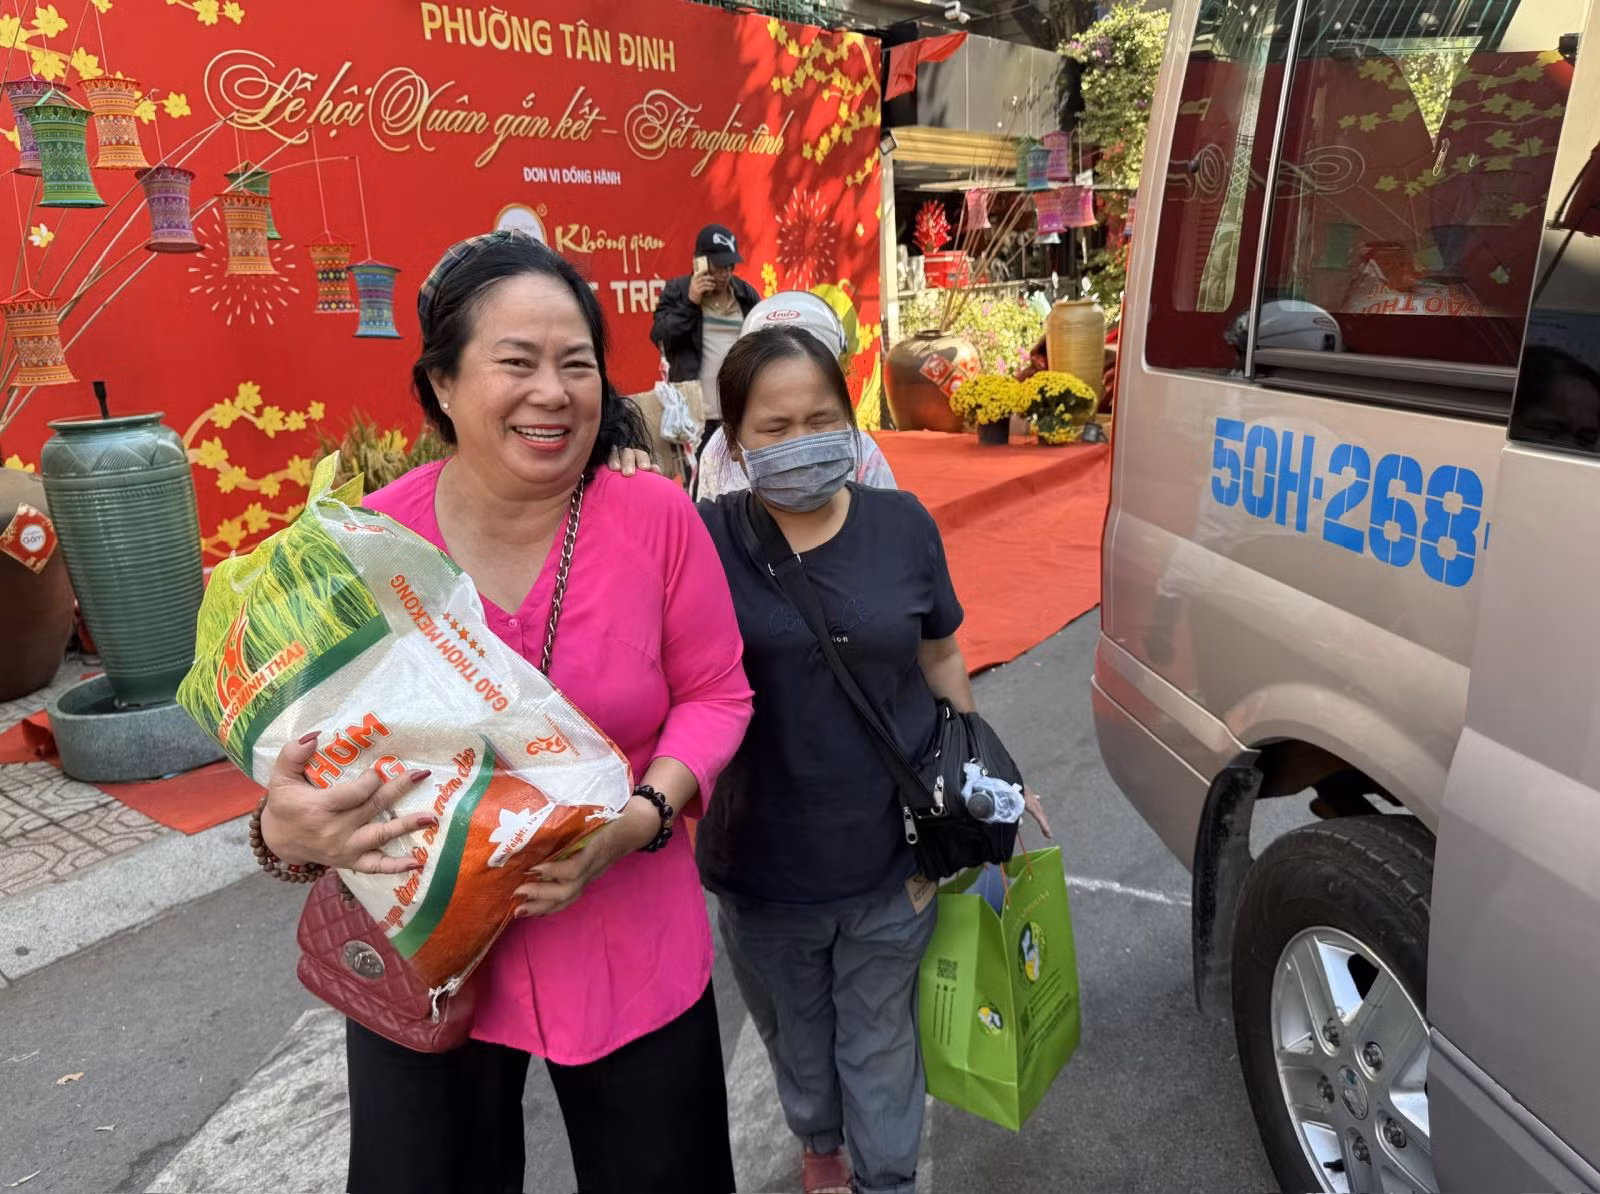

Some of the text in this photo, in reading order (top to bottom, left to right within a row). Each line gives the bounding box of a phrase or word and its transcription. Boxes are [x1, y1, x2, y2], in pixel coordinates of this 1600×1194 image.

[421, 2, 676, 72] PHƯỜNG TÂN ĐỊNH
[204, 49, 318, 144] Lễ
[307, 61, 373, 138] hội
[368, 66, 489, 152] Xuân
[475, 92, 551, 168] gắn
[551, 86, 606, 141] kết
[624, 89, 702, 160] Tết
[691, 103, 749, 177] nghĩa
[748, 110, 795, 156] tình
[555, 223, 665, 275] Không gian
[390, 574, 444, 643] MEKONG
[303, 711, 392, 790] HƠM
